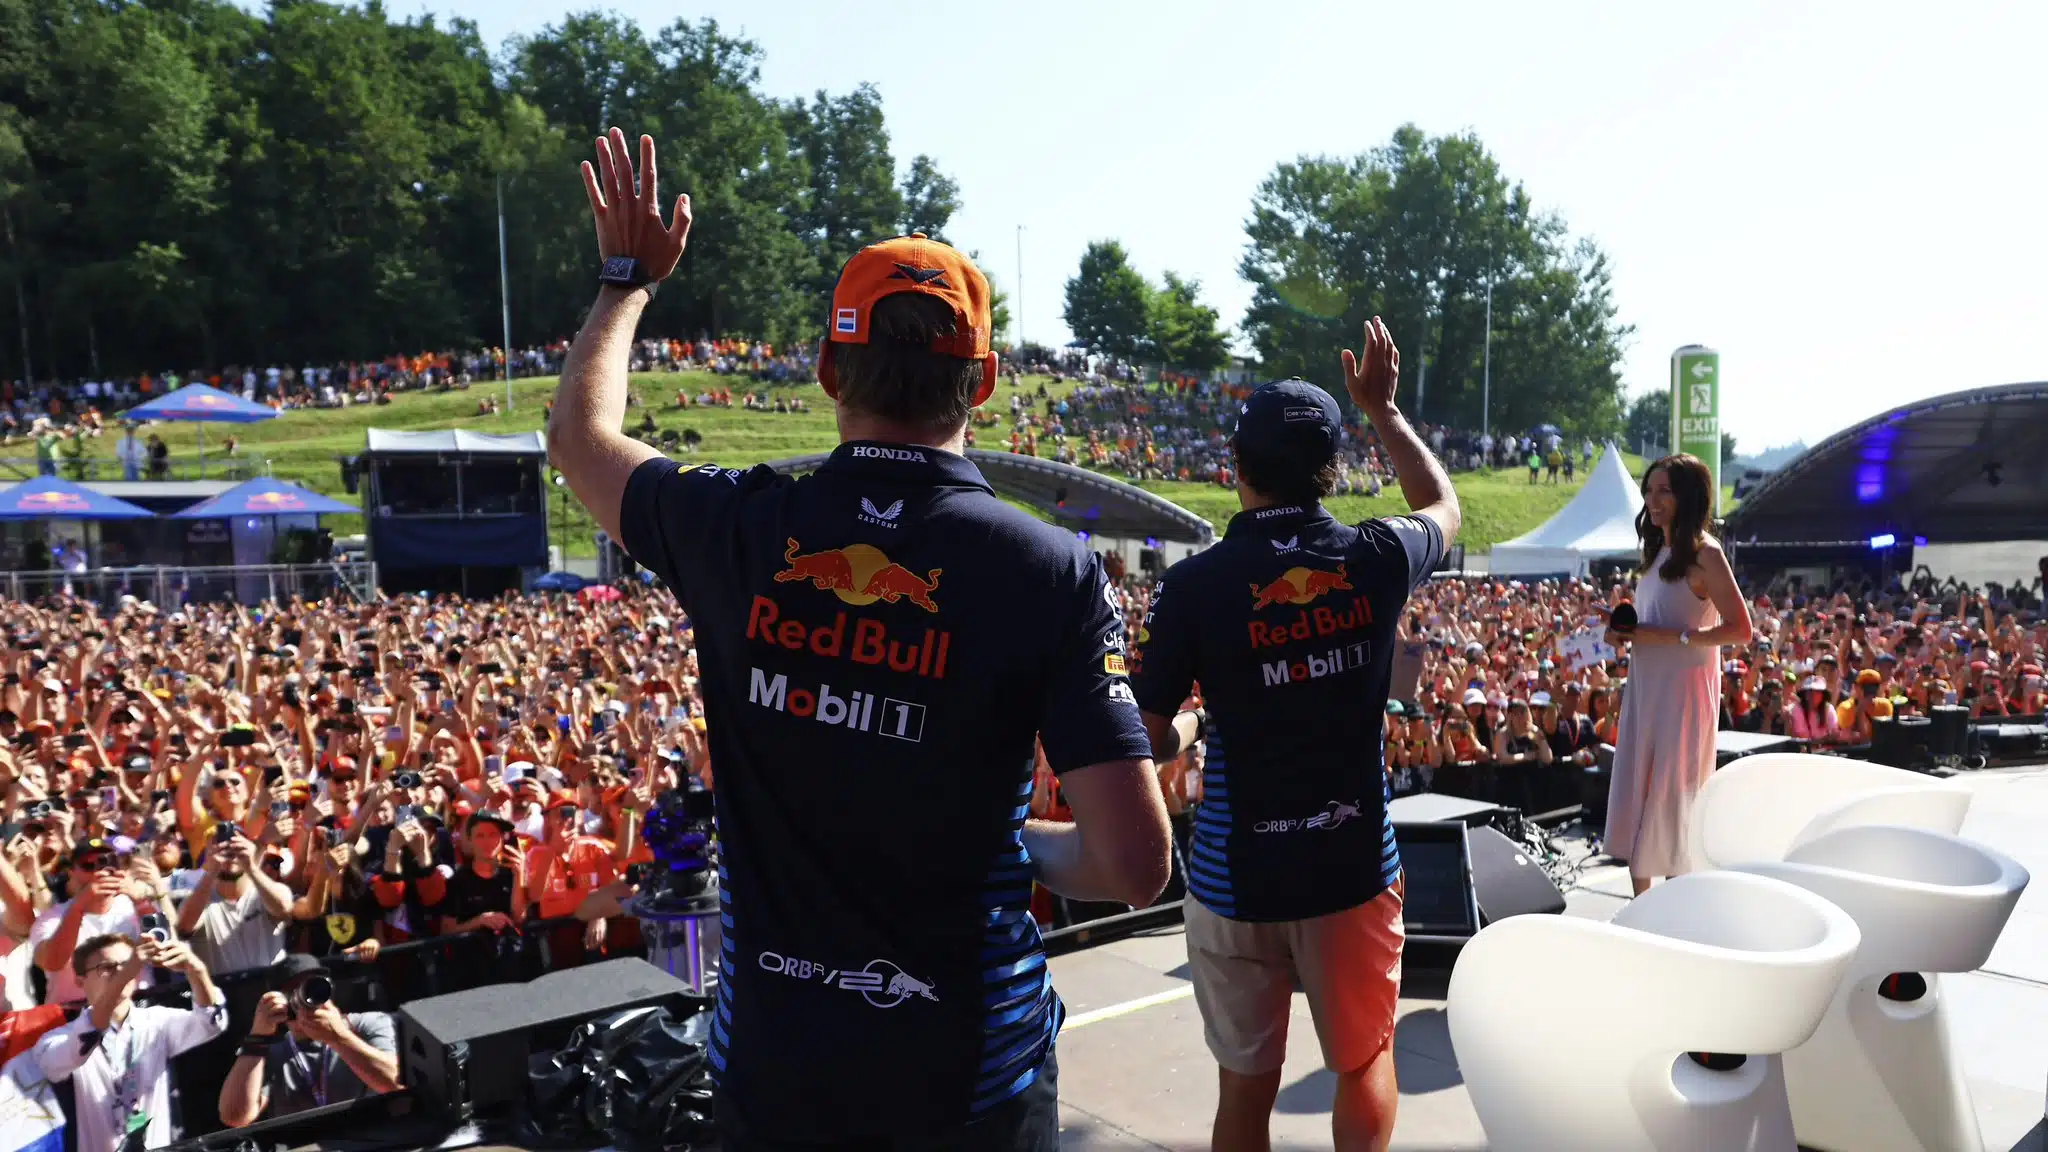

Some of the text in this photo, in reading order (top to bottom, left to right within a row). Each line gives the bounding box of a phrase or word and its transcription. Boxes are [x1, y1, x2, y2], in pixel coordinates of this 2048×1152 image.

[1682, 416, 1717, 434] EXIT
[852, 446, 928, 463] HONDA
[857, 513, 898, 529] CASTORE
[1255, 506, 1304, 519] HONDA
[1247, 595, 1373, 649] Red Bull
[746, 594, 950, 679] Red Bull
[1262, 648, 1343, 687] Mobil
[749, 666, 874, 731] Mobil
